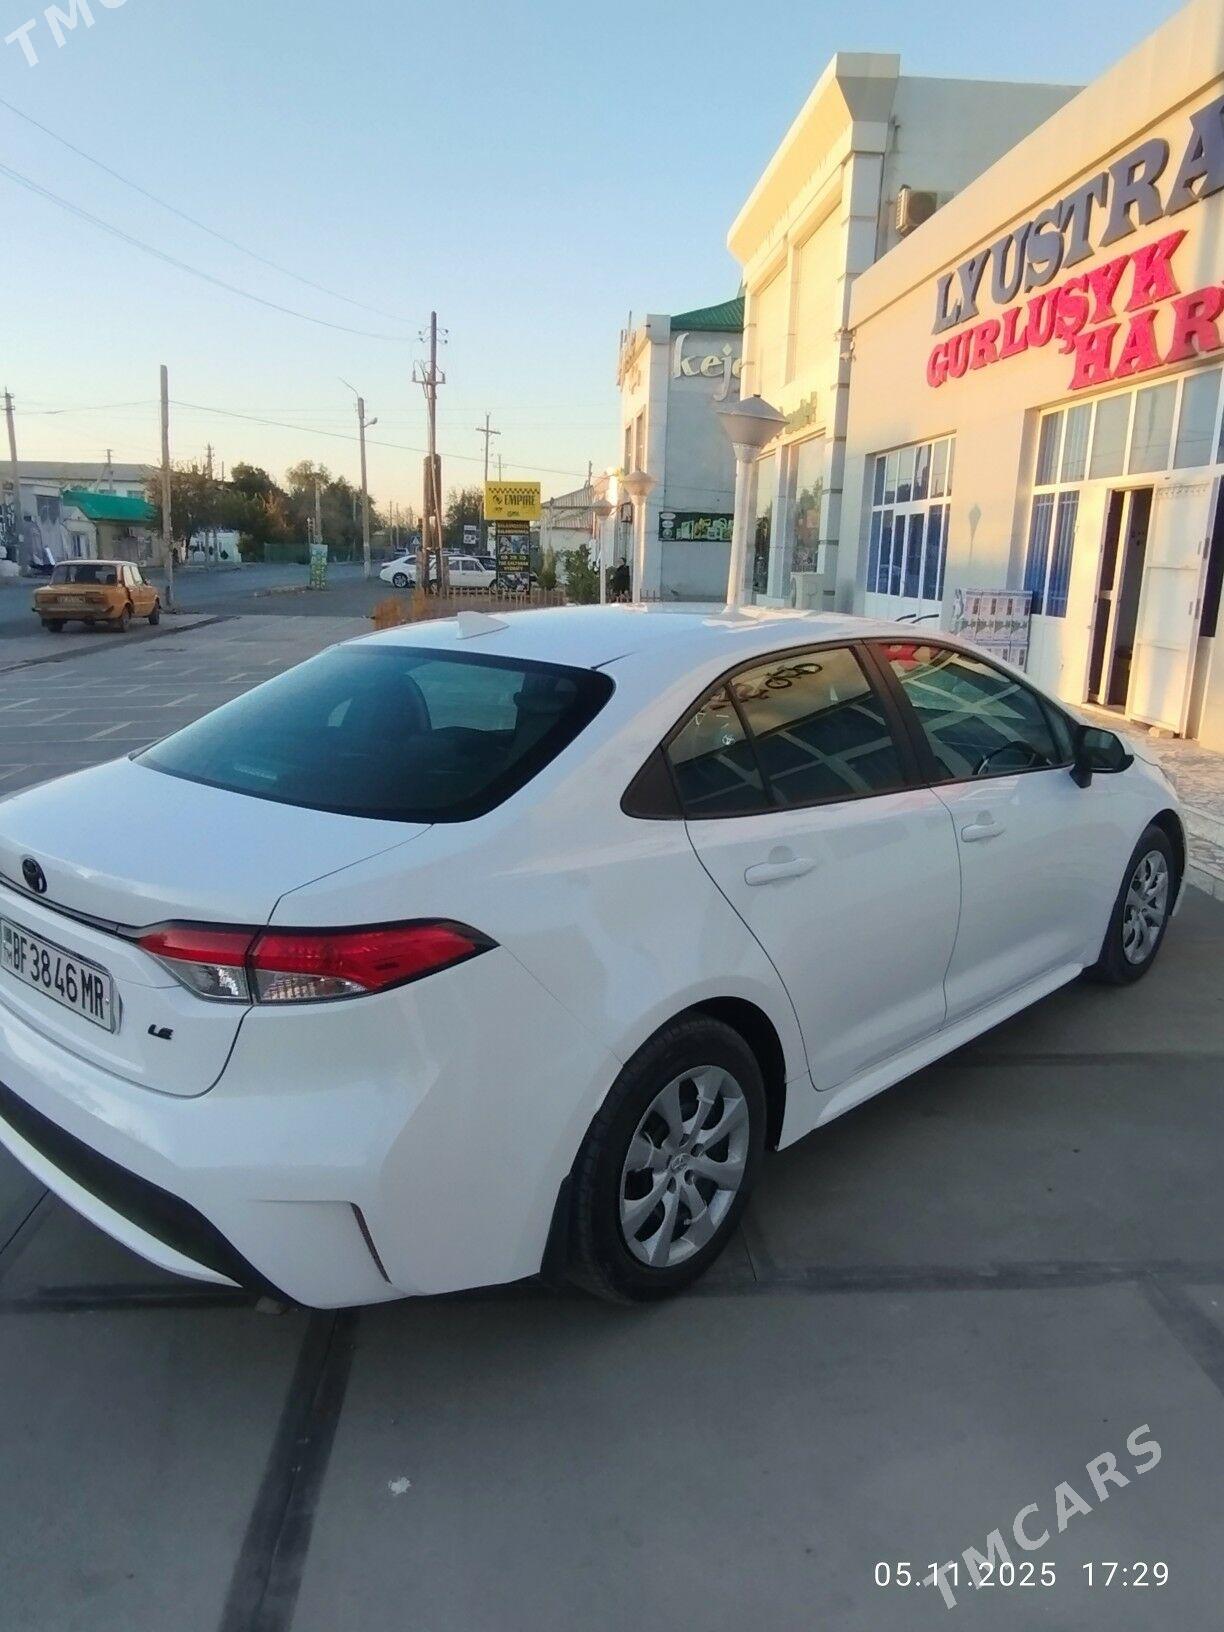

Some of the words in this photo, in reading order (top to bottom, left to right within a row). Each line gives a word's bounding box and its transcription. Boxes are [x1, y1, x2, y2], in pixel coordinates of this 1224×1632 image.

[930, 95, 1224, 335] LYUSTRA
[927, 229, 1188, 388] GURLUŞYK
[1067, 281, 1224, 390] HAR
[504, 494, 536, 506] EMPIRE
[147, 1023, 174, 1040] LE
